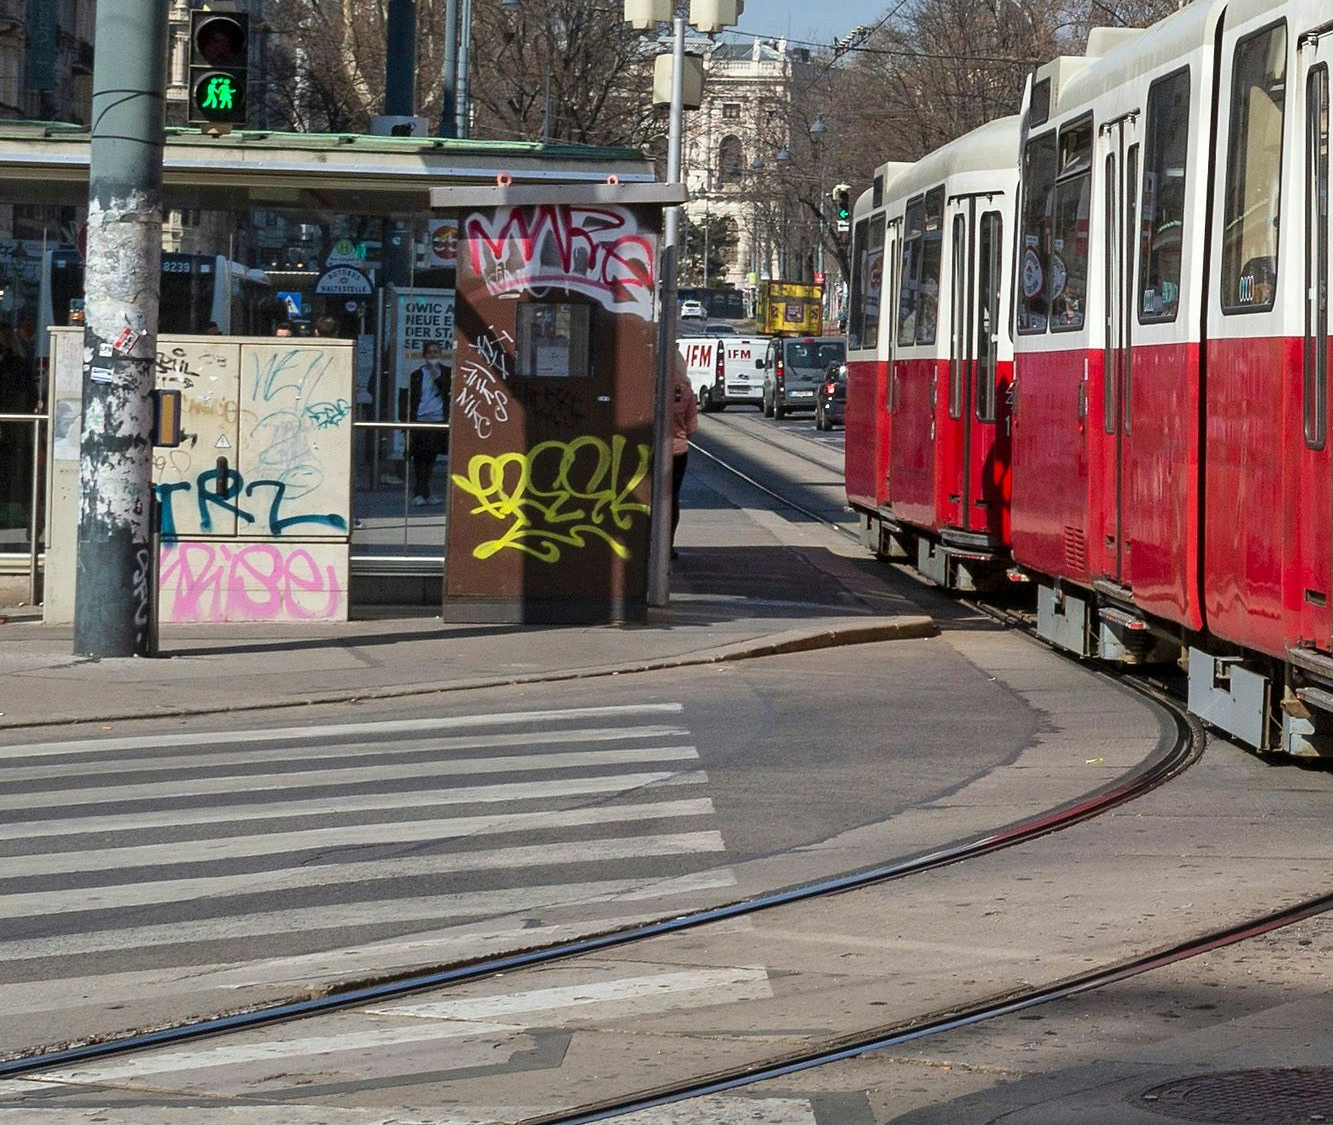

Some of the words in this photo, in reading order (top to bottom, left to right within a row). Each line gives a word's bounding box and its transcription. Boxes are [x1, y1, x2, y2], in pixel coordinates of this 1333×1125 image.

[163, 261, 190, 272] 8239
[405, 314, 440, 326] NEUE
[405, 327, 431, 338] DER
[685, 344, 712, 368] IFM
[728, 349, 751, 359] IFM
